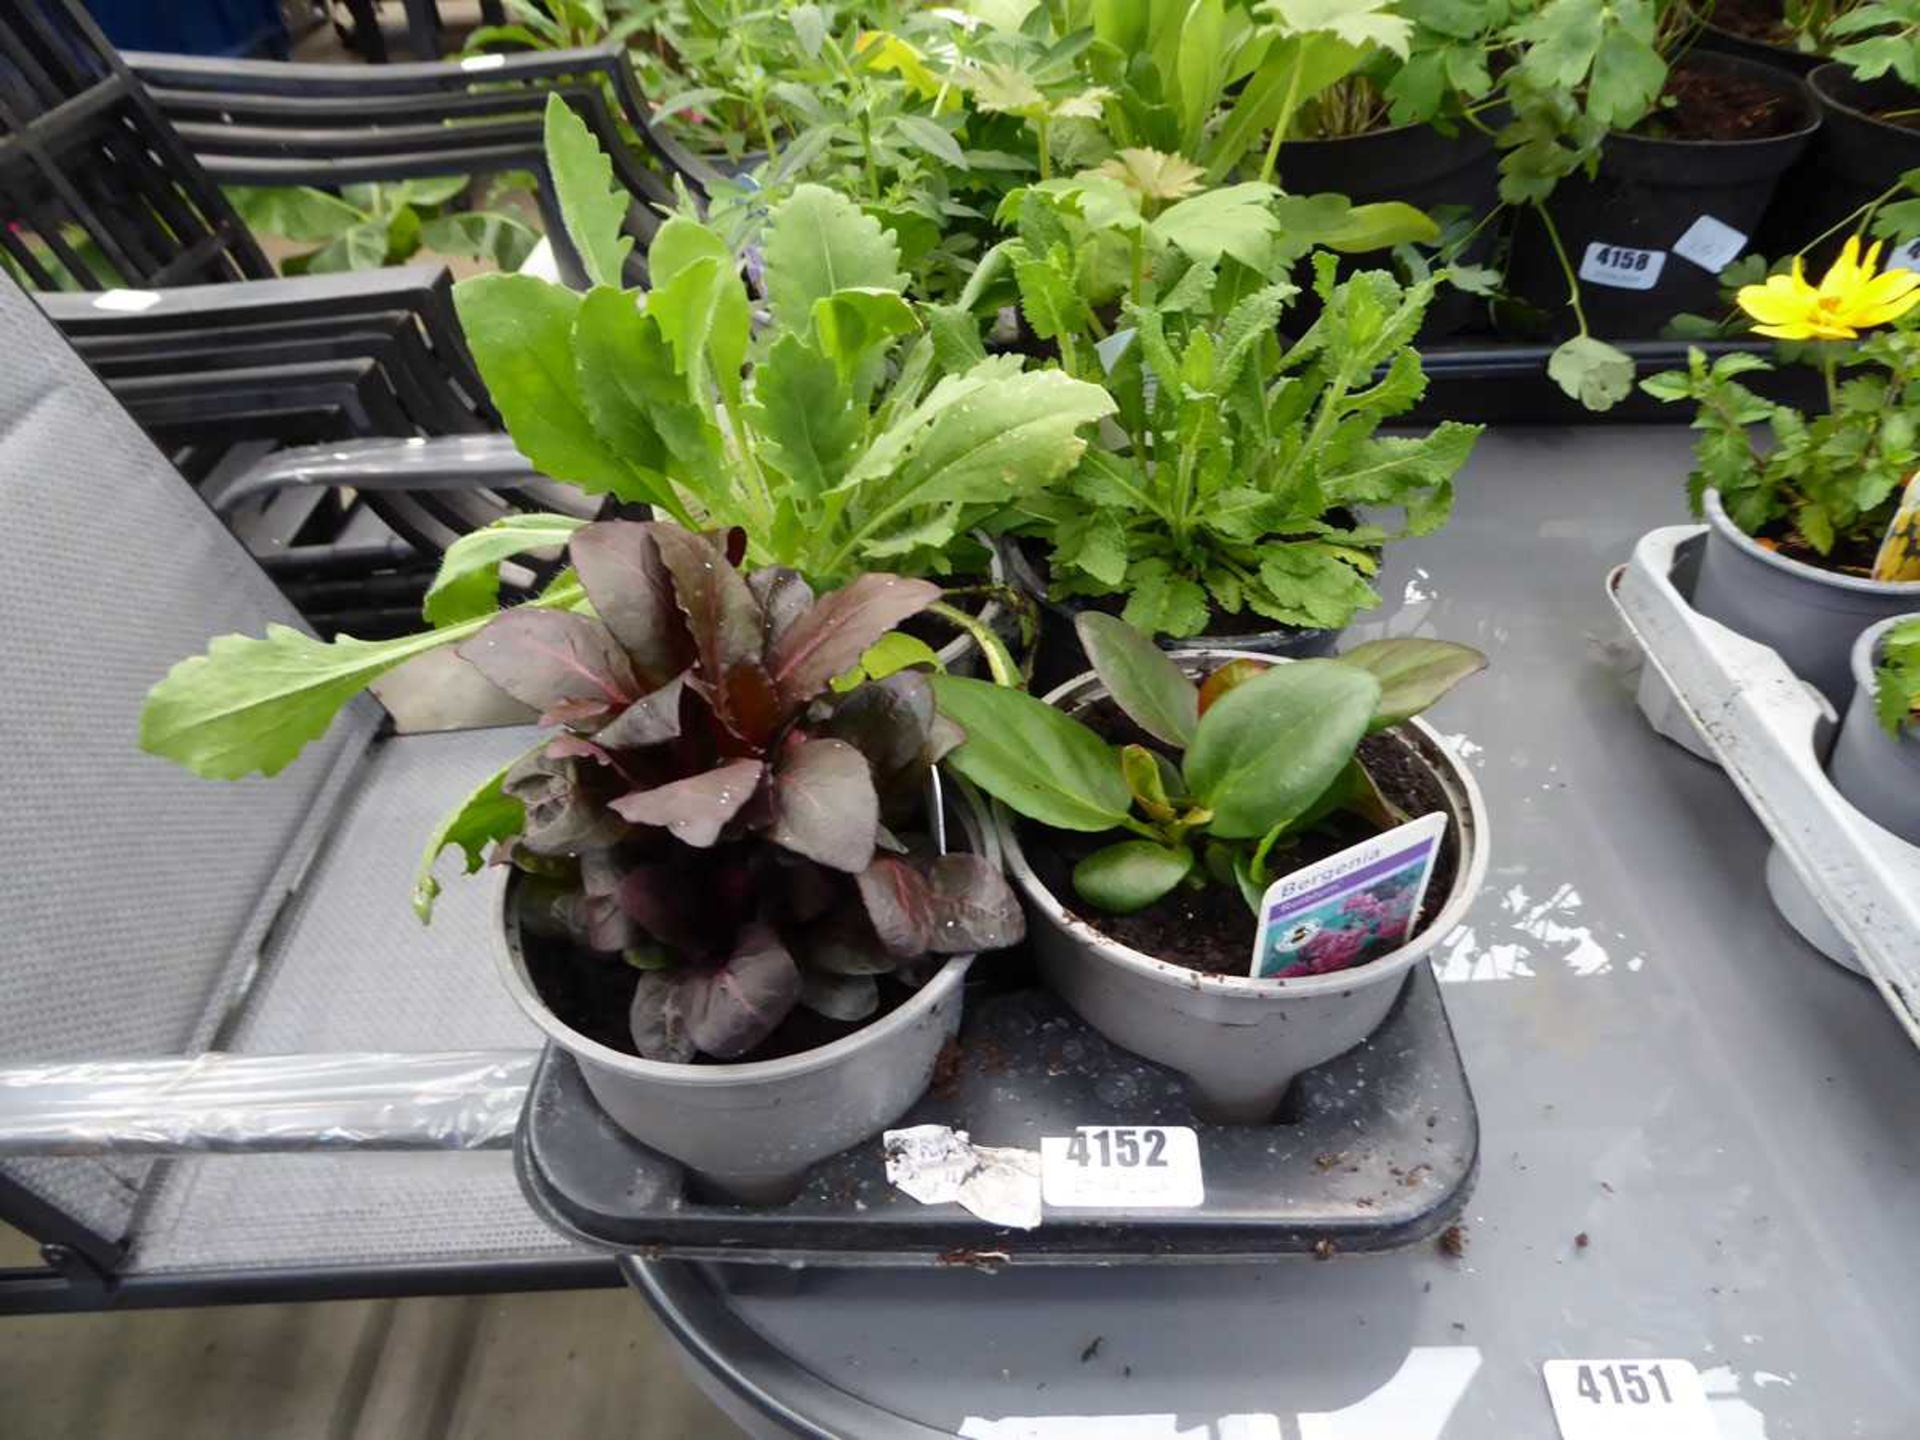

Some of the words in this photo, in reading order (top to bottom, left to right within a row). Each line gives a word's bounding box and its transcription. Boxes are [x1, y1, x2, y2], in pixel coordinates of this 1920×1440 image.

[1596, 247, 1651, 271] 4158
[1281, 847, 1381, 898] Bergenia
[1065, 1128, 1169, 1168] 4152
[1577, 1364, 1673, 1404] 4151
